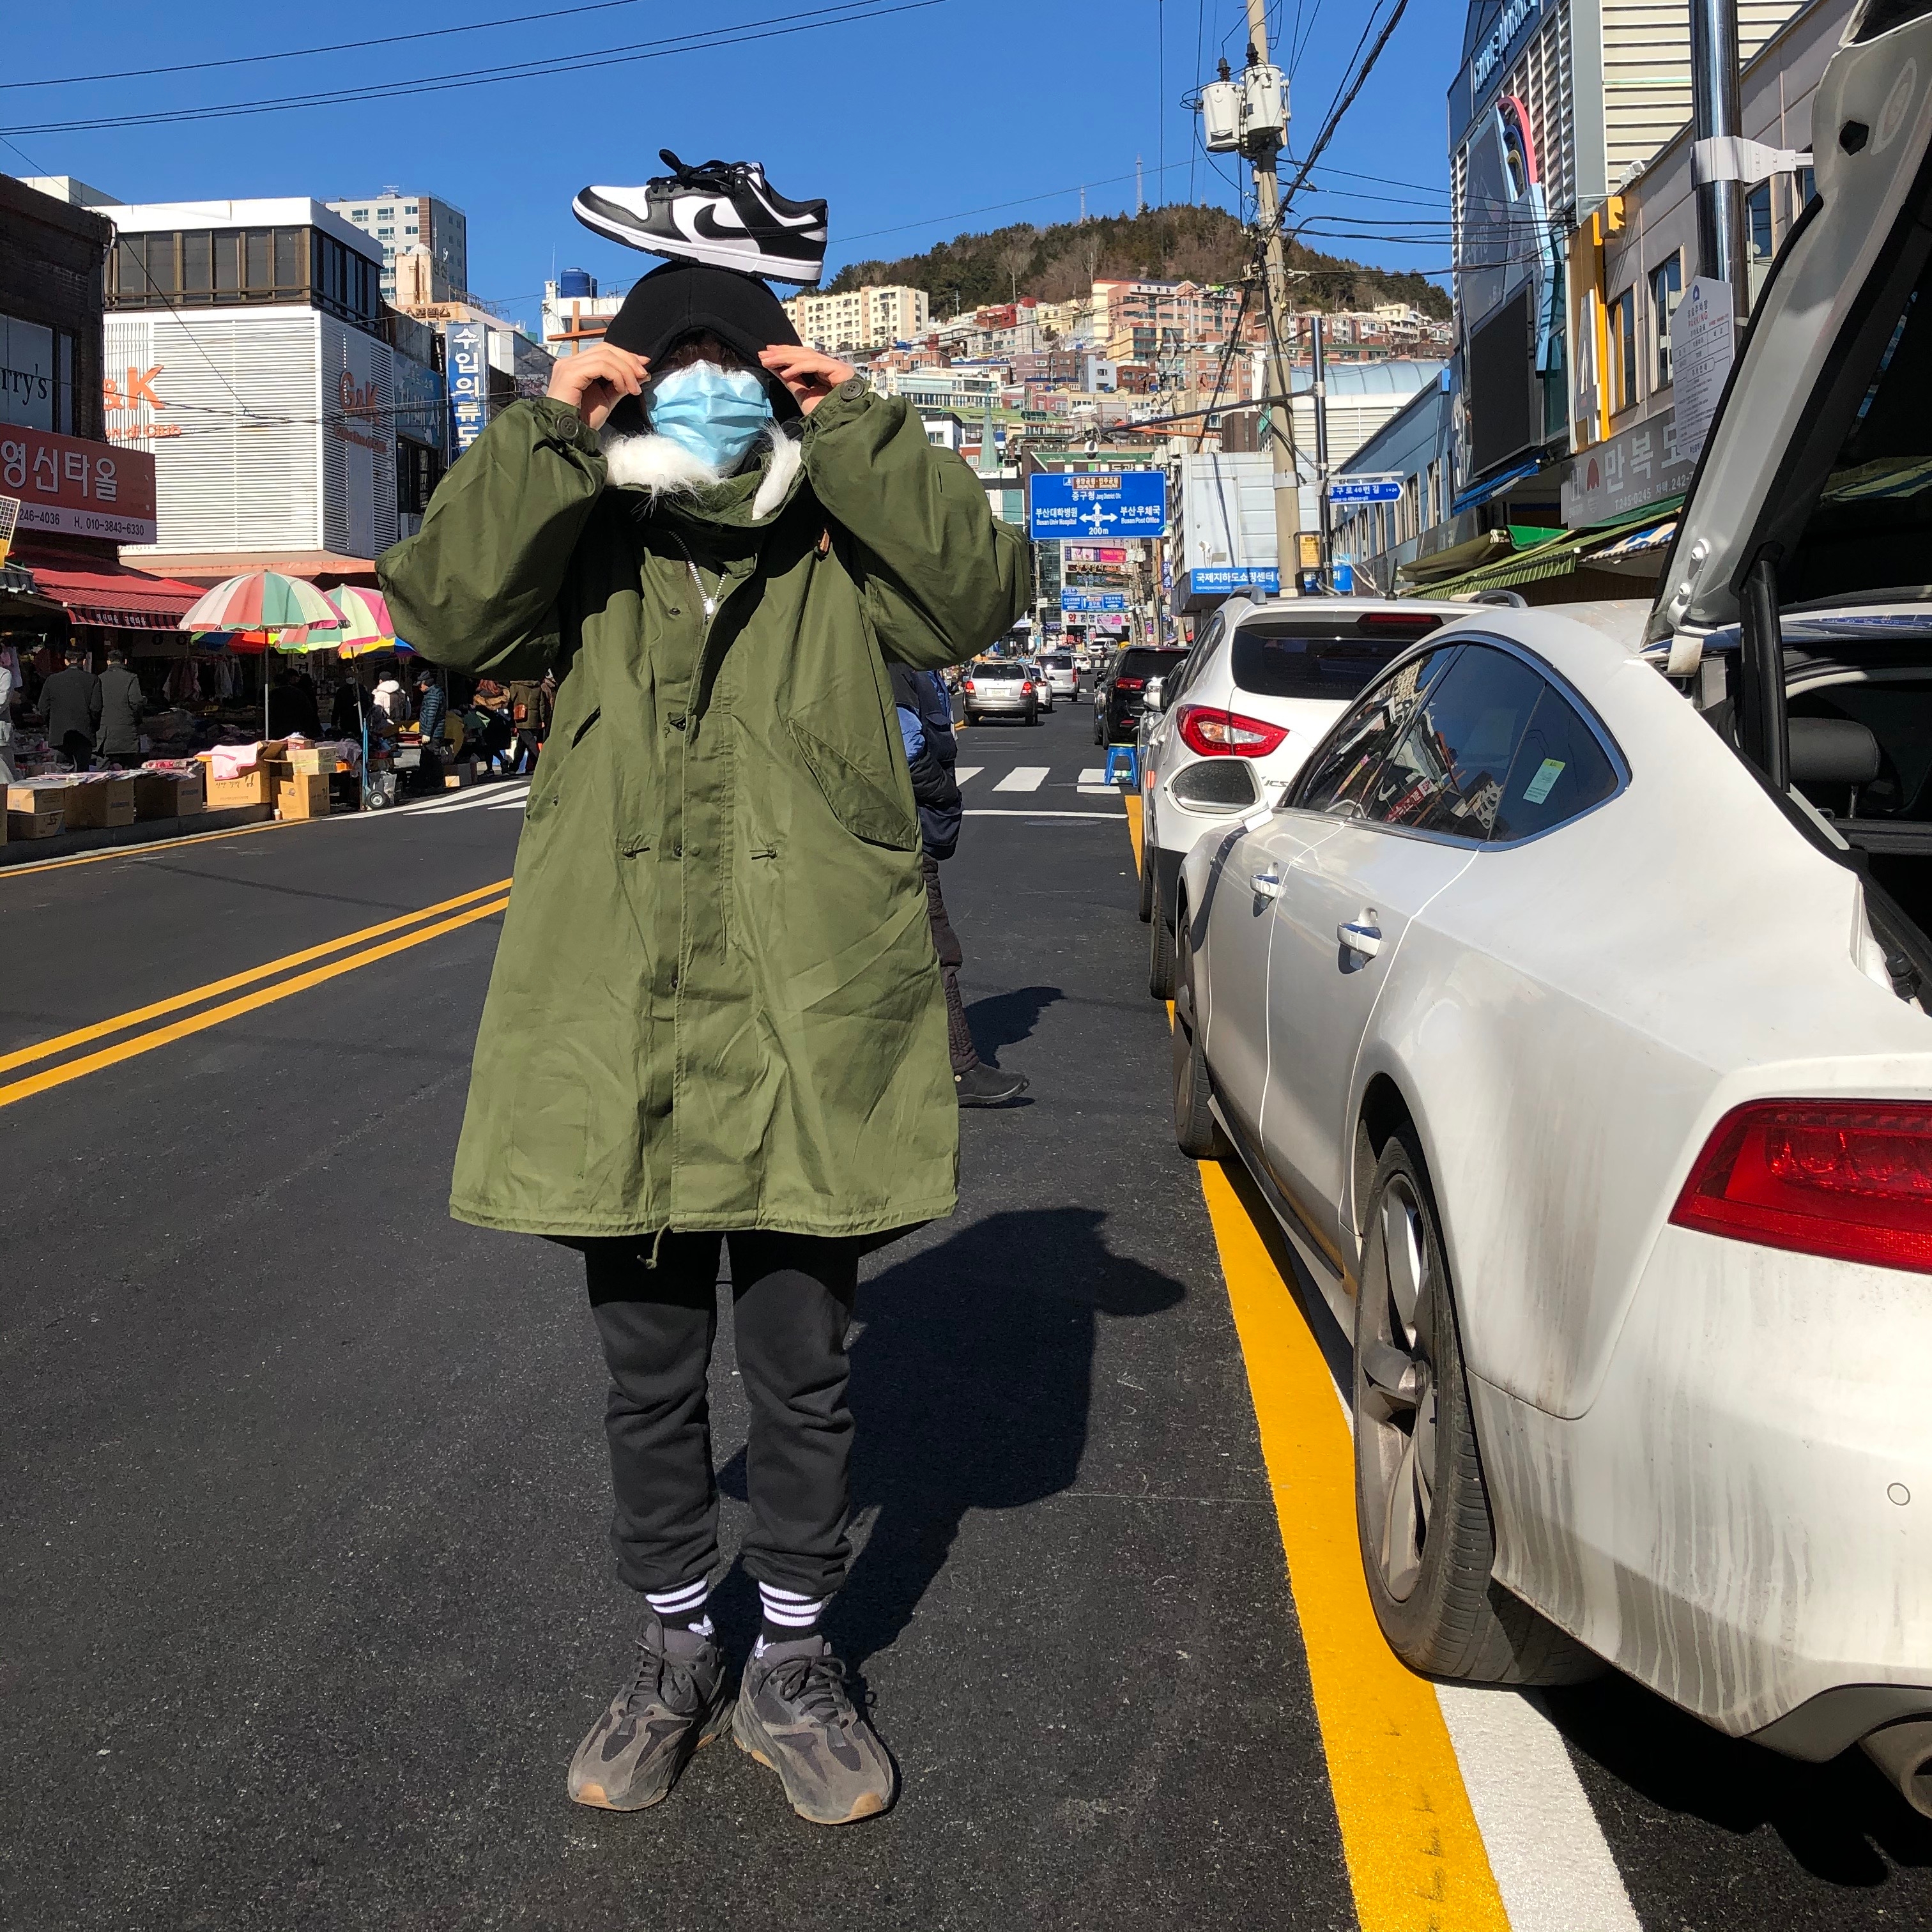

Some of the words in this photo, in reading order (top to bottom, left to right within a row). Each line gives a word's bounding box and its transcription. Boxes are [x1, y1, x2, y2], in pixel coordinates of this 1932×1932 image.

[1, 440, 118, 502] 영신타올
[1071, 491, 1095, 501] 중구청
[1035, 507, 1078, 518] 부산대학병원
[1119, 505, 1161, 517] 부산우체국
[19, 508, 60, 526] 246-4036
[74, 516, 83, 530] H.
[86, 518, 145, 536] 010-3843-6330
[1088, 526, 1109, 535] 200m
[1195, 571, 1274, 583] 국제지하도쇼핑센터
